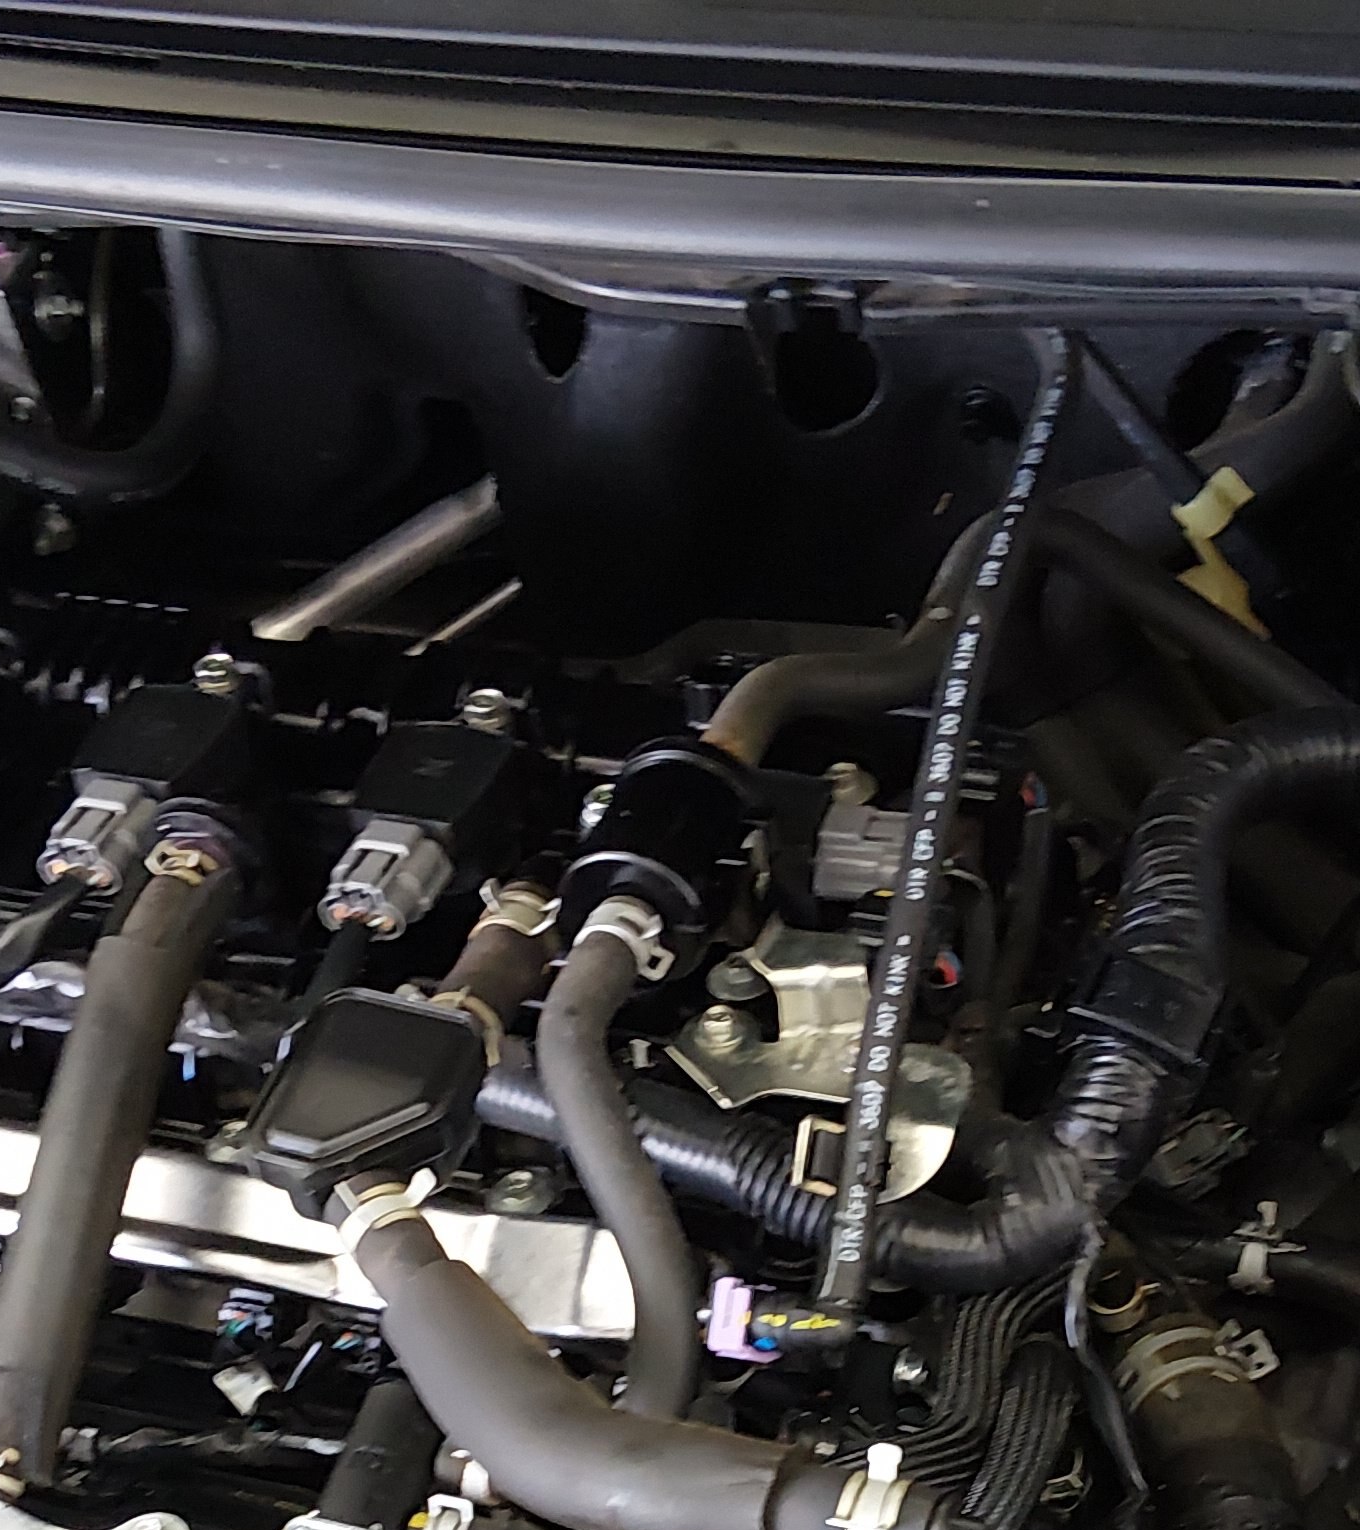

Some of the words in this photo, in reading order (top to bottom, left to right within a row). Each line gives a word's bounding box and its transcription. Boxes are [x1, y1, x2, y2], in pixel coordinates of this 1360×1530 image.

[950, 631, 980, 671] KINK
[942, 678, 969, 708] NOT
[936, 713, 962, 736] DO
[883, 953, 912, 996] KINK
[873, 1002, 900, 1038] NOT
[867, 1045, 892, 1072] DO
